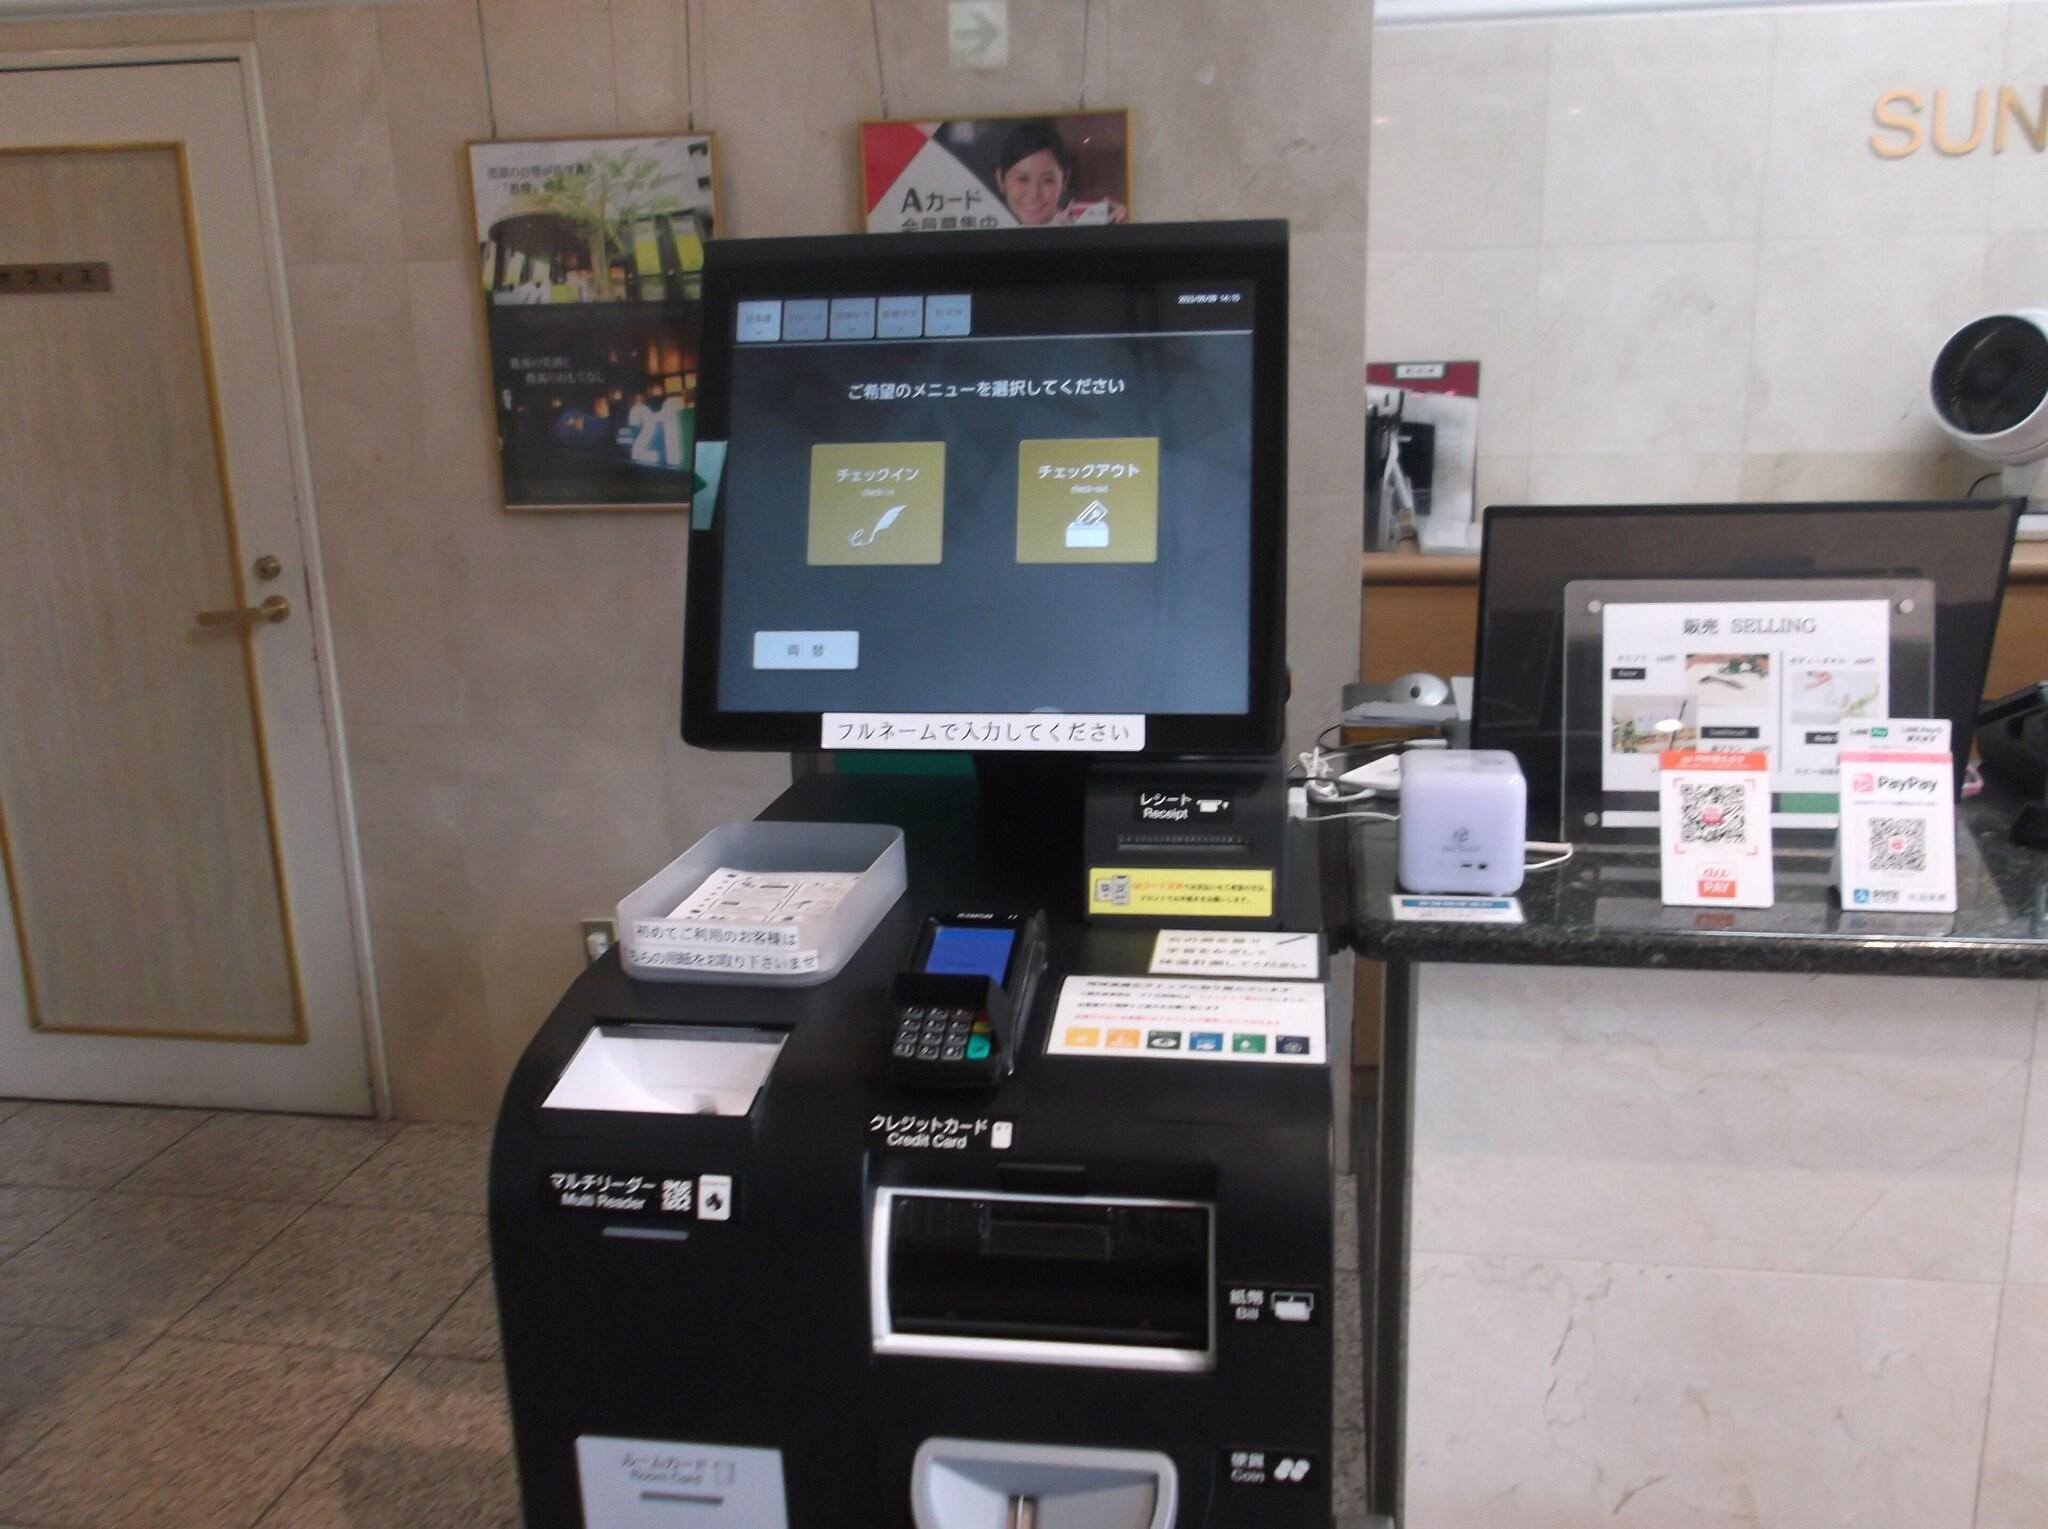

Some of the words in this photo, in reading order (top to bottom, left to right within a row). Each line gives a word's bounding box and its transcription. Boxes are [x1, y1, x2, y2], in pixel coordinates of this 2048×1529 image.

[1870, 86, 2048, 159] SUN
[901, 188, 982, 213] Aカード
[848, 377, 1126, 401] ご希望のメニューを選択してください
[836, 467, 919, 483] チェックイン
[1037, 463, 1140, 480] チェックアウト
[1681, 617, 1719, 636] 販売
[1729, 617, 1818, 635] SELLING
[838, 720, 1130, 743] フルネームで入力してください
[1878, 774, 1938, 792] PayPay
[1140, 793, 1192, 806] レシート
[1143, 806, 1189, 821] Receipt
[635, 923, 797, 946] 初めてご利用のお客様は
[870, 1113, 989, 1136] クレジットカード
[886, 1131, 931, 1148] Credit
[932, 1133, 969, 1150] Card
[550, 1172, 656, 1194] マルチリーダー
[1231, 1468, 1265, 1484] Coin
